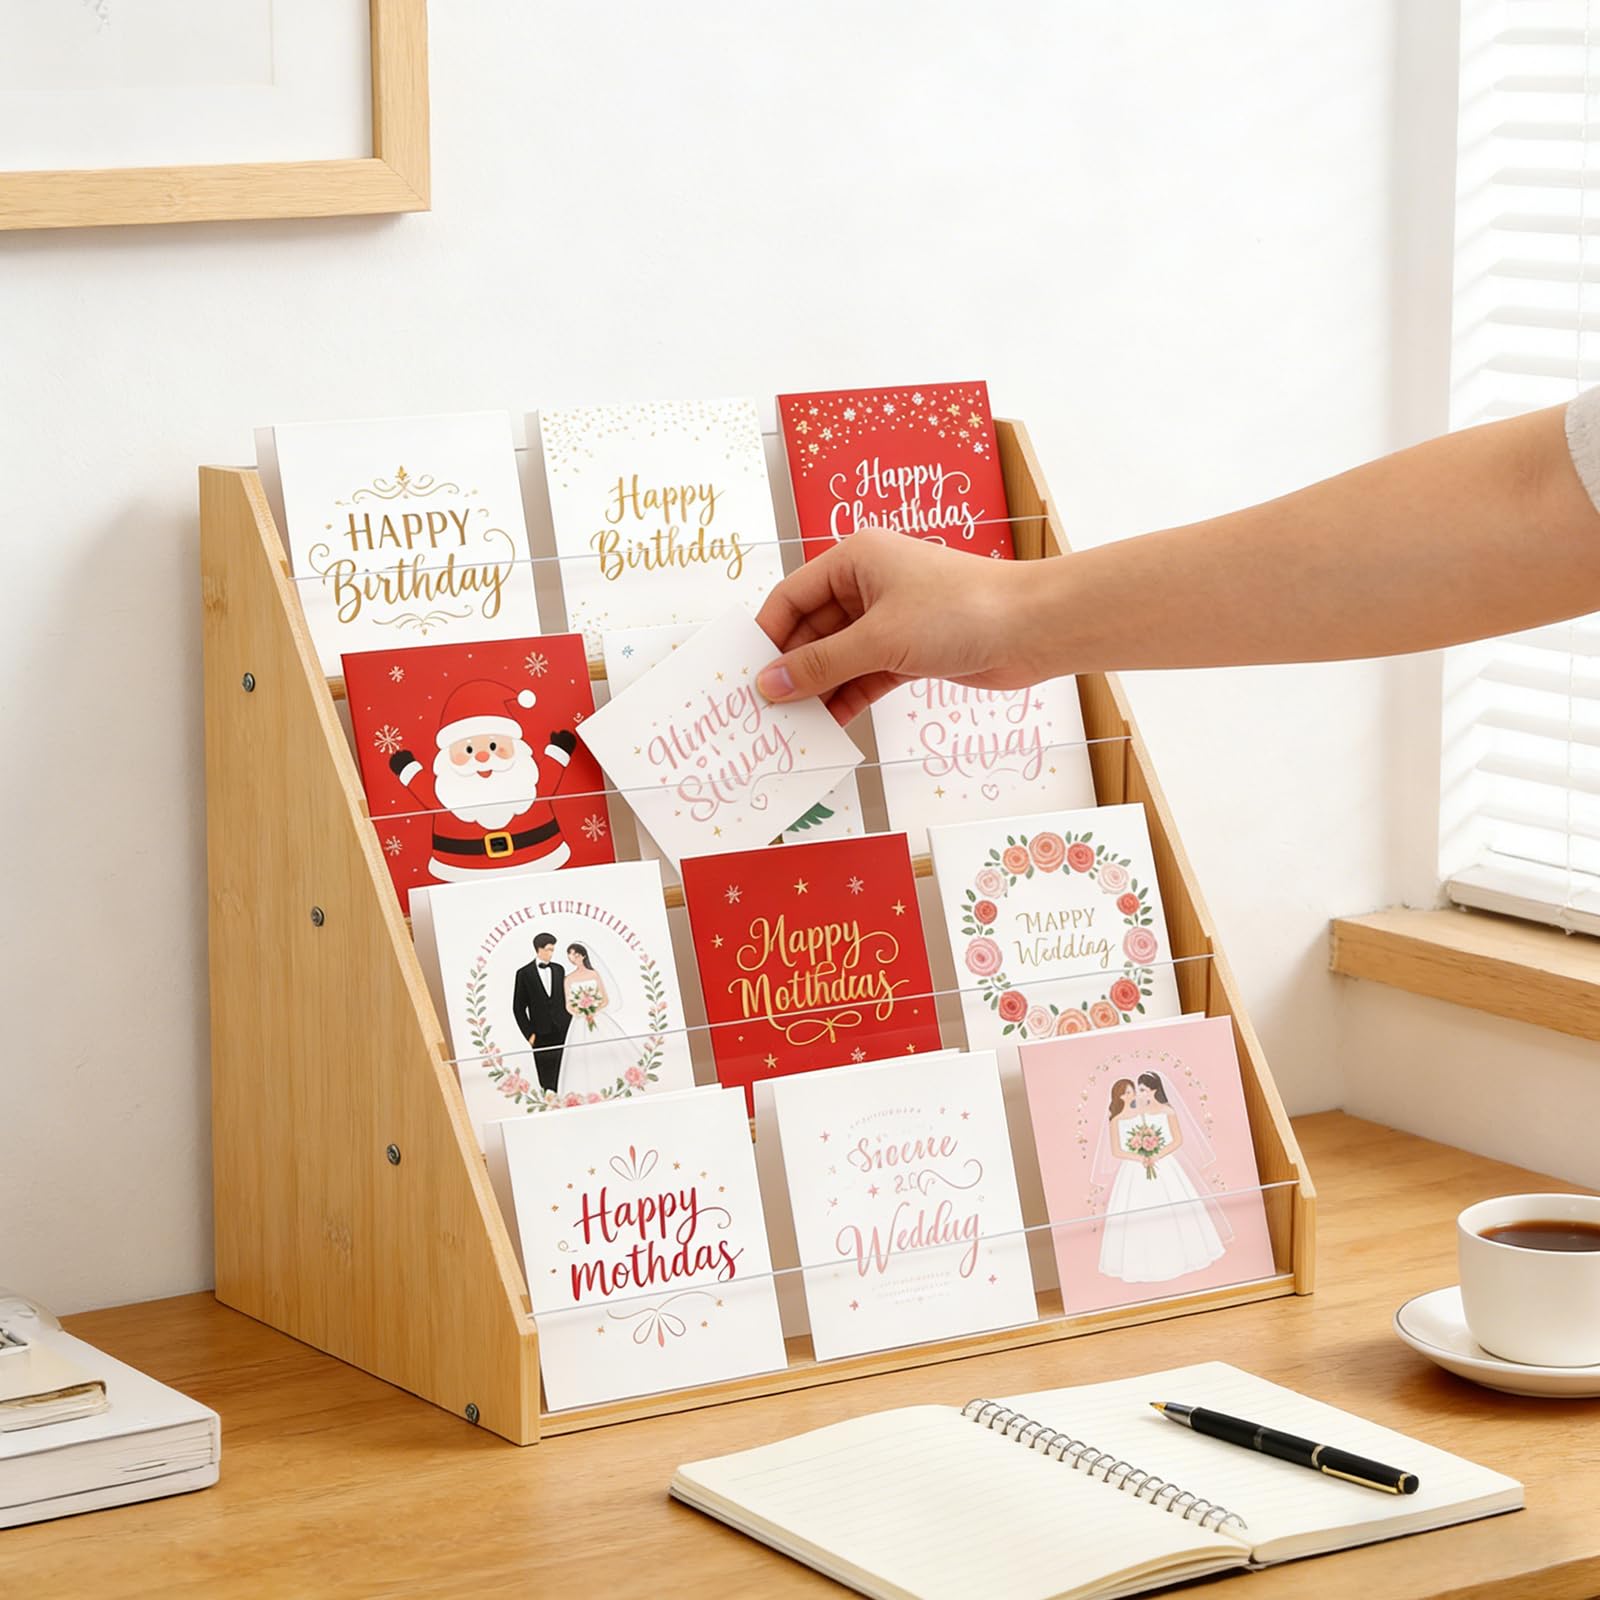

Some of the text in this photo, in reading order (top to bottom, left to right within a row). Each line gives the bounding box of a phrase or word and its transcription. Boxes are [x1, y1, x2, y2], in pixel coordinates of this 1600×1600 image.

[605, 474, 725, 527] Happy
[856, 457, 970, 500] Happy
[344, 508, 470, 551] HAPPY
[309, 545, 515, 624] Birthday
[737, 914, 899, 972] Happy
[573, 1187, 731, 1245] Happy
